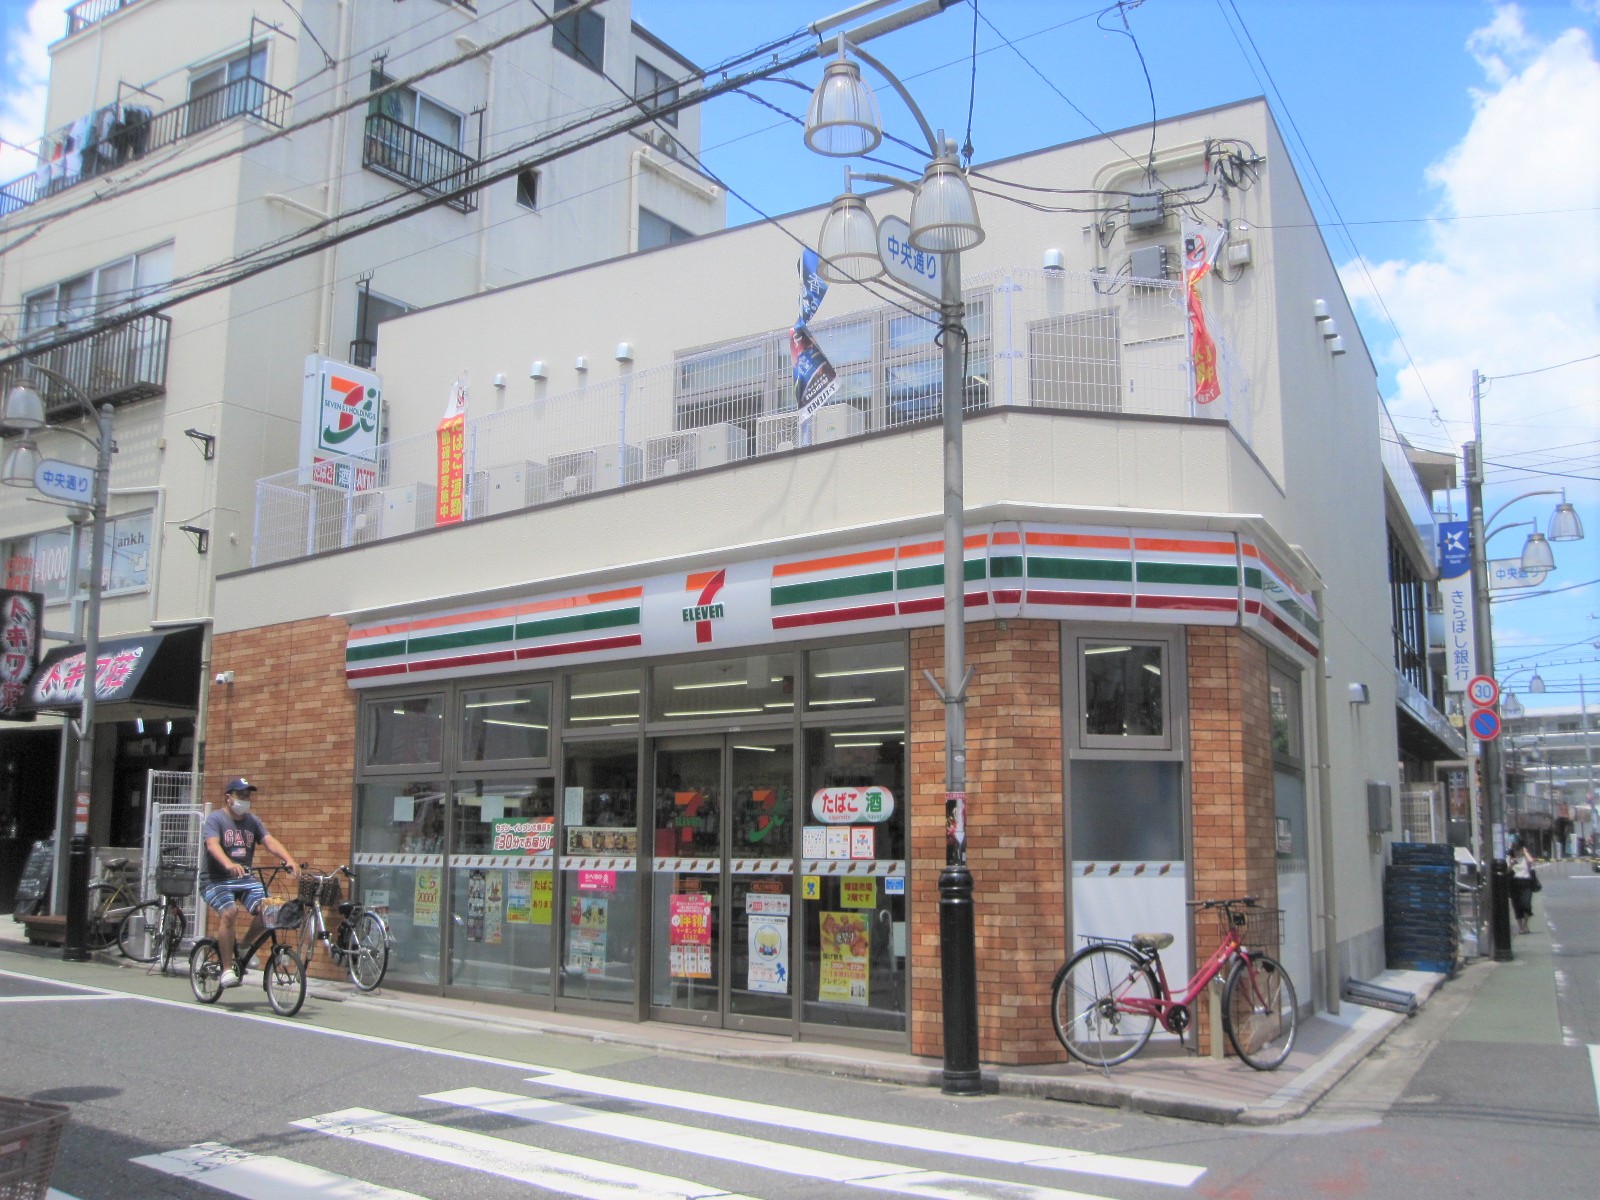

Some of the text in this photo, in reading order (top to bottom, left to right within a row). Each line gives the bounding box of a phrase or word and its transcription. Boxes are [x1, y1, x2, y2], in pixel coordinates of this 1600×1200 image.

[887, 235, 937, 280] 中央通り
[348, 407, 376, 421] HOLDINGS
[43, 471, 89, 493] 中央通り
[356, 472, 375, 490] ATM
[117, 531, 145, 548] ankh
[1451, 590, 1469, 680] きらぼし銀行
[1474, 684, 1492, 699] 30
[822, 793, 858, 813] たばこ
[866, 791, 882, 812] 酒
[224, 829, 255, 848] GAP
